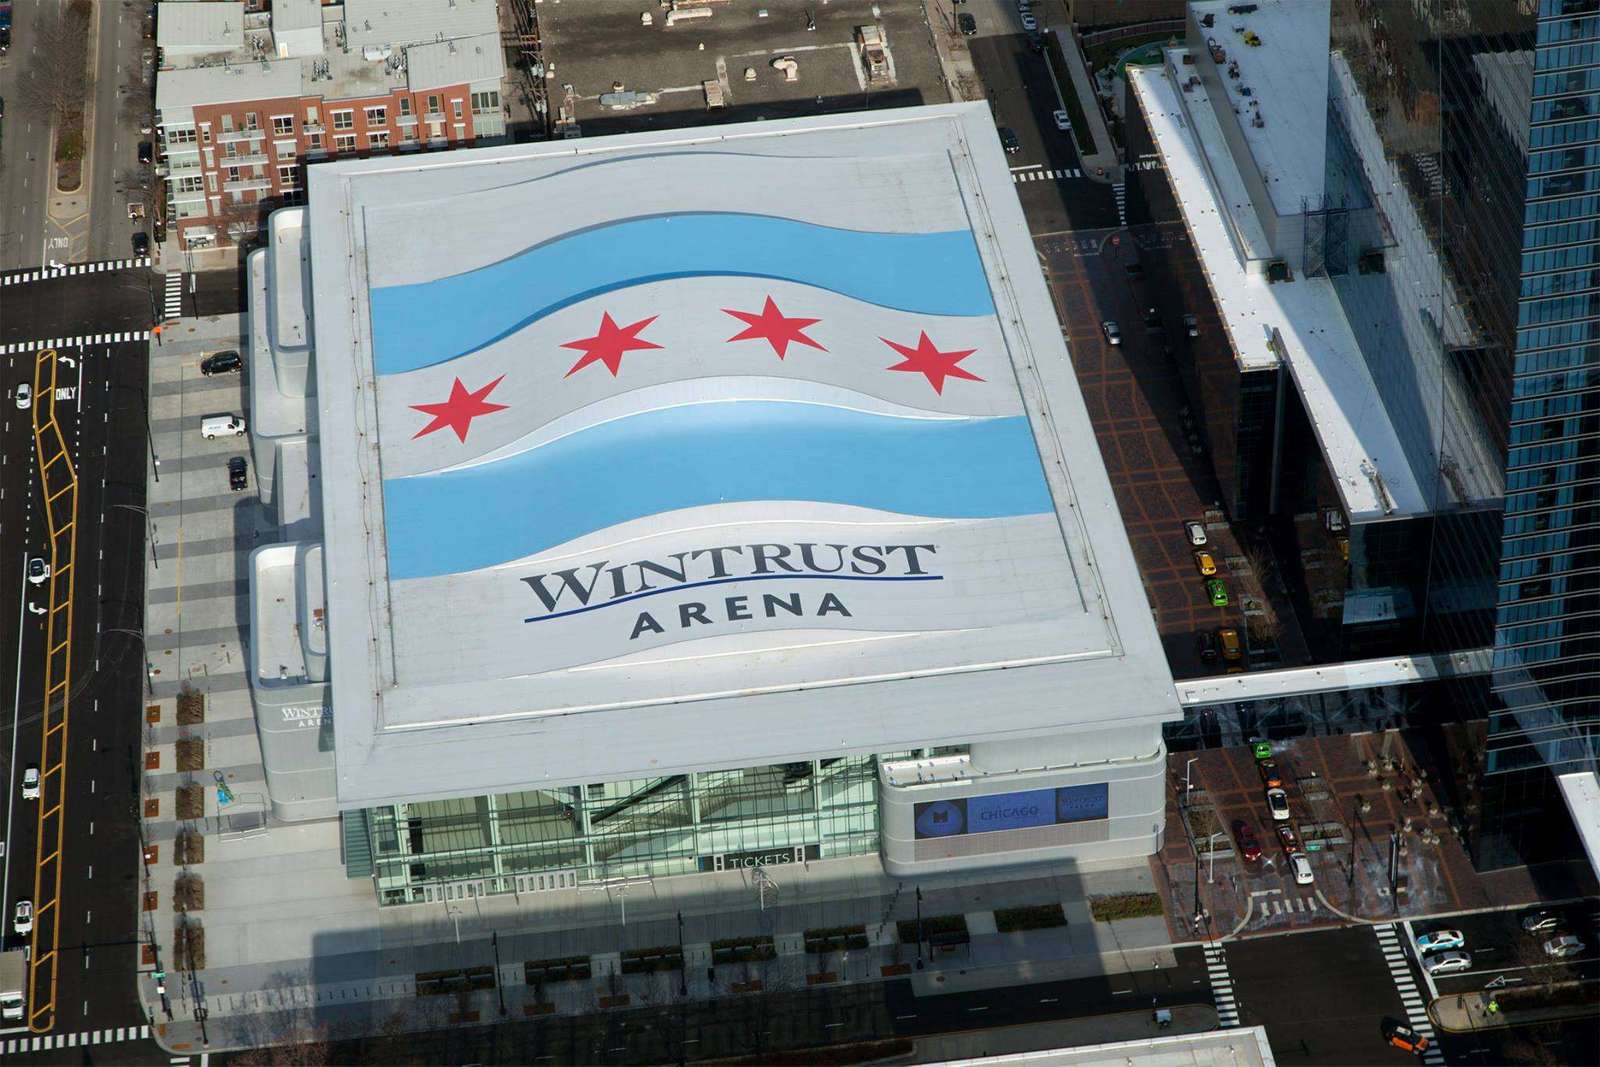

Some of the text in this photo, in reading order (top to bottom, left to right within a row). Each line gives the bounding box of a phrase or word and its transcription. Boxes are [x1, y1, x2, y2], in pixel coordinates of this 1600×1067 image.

[48, 236, 69, 249] ONLY
[55, 386, 77, 400] ONLY
[520, 542, 937, 613] WINTRUST
[629, 592, 853, 640] ARENA
[980, 804, 1039, 821] CHICAGO
[729, 852, 790, 870] TICKETS
